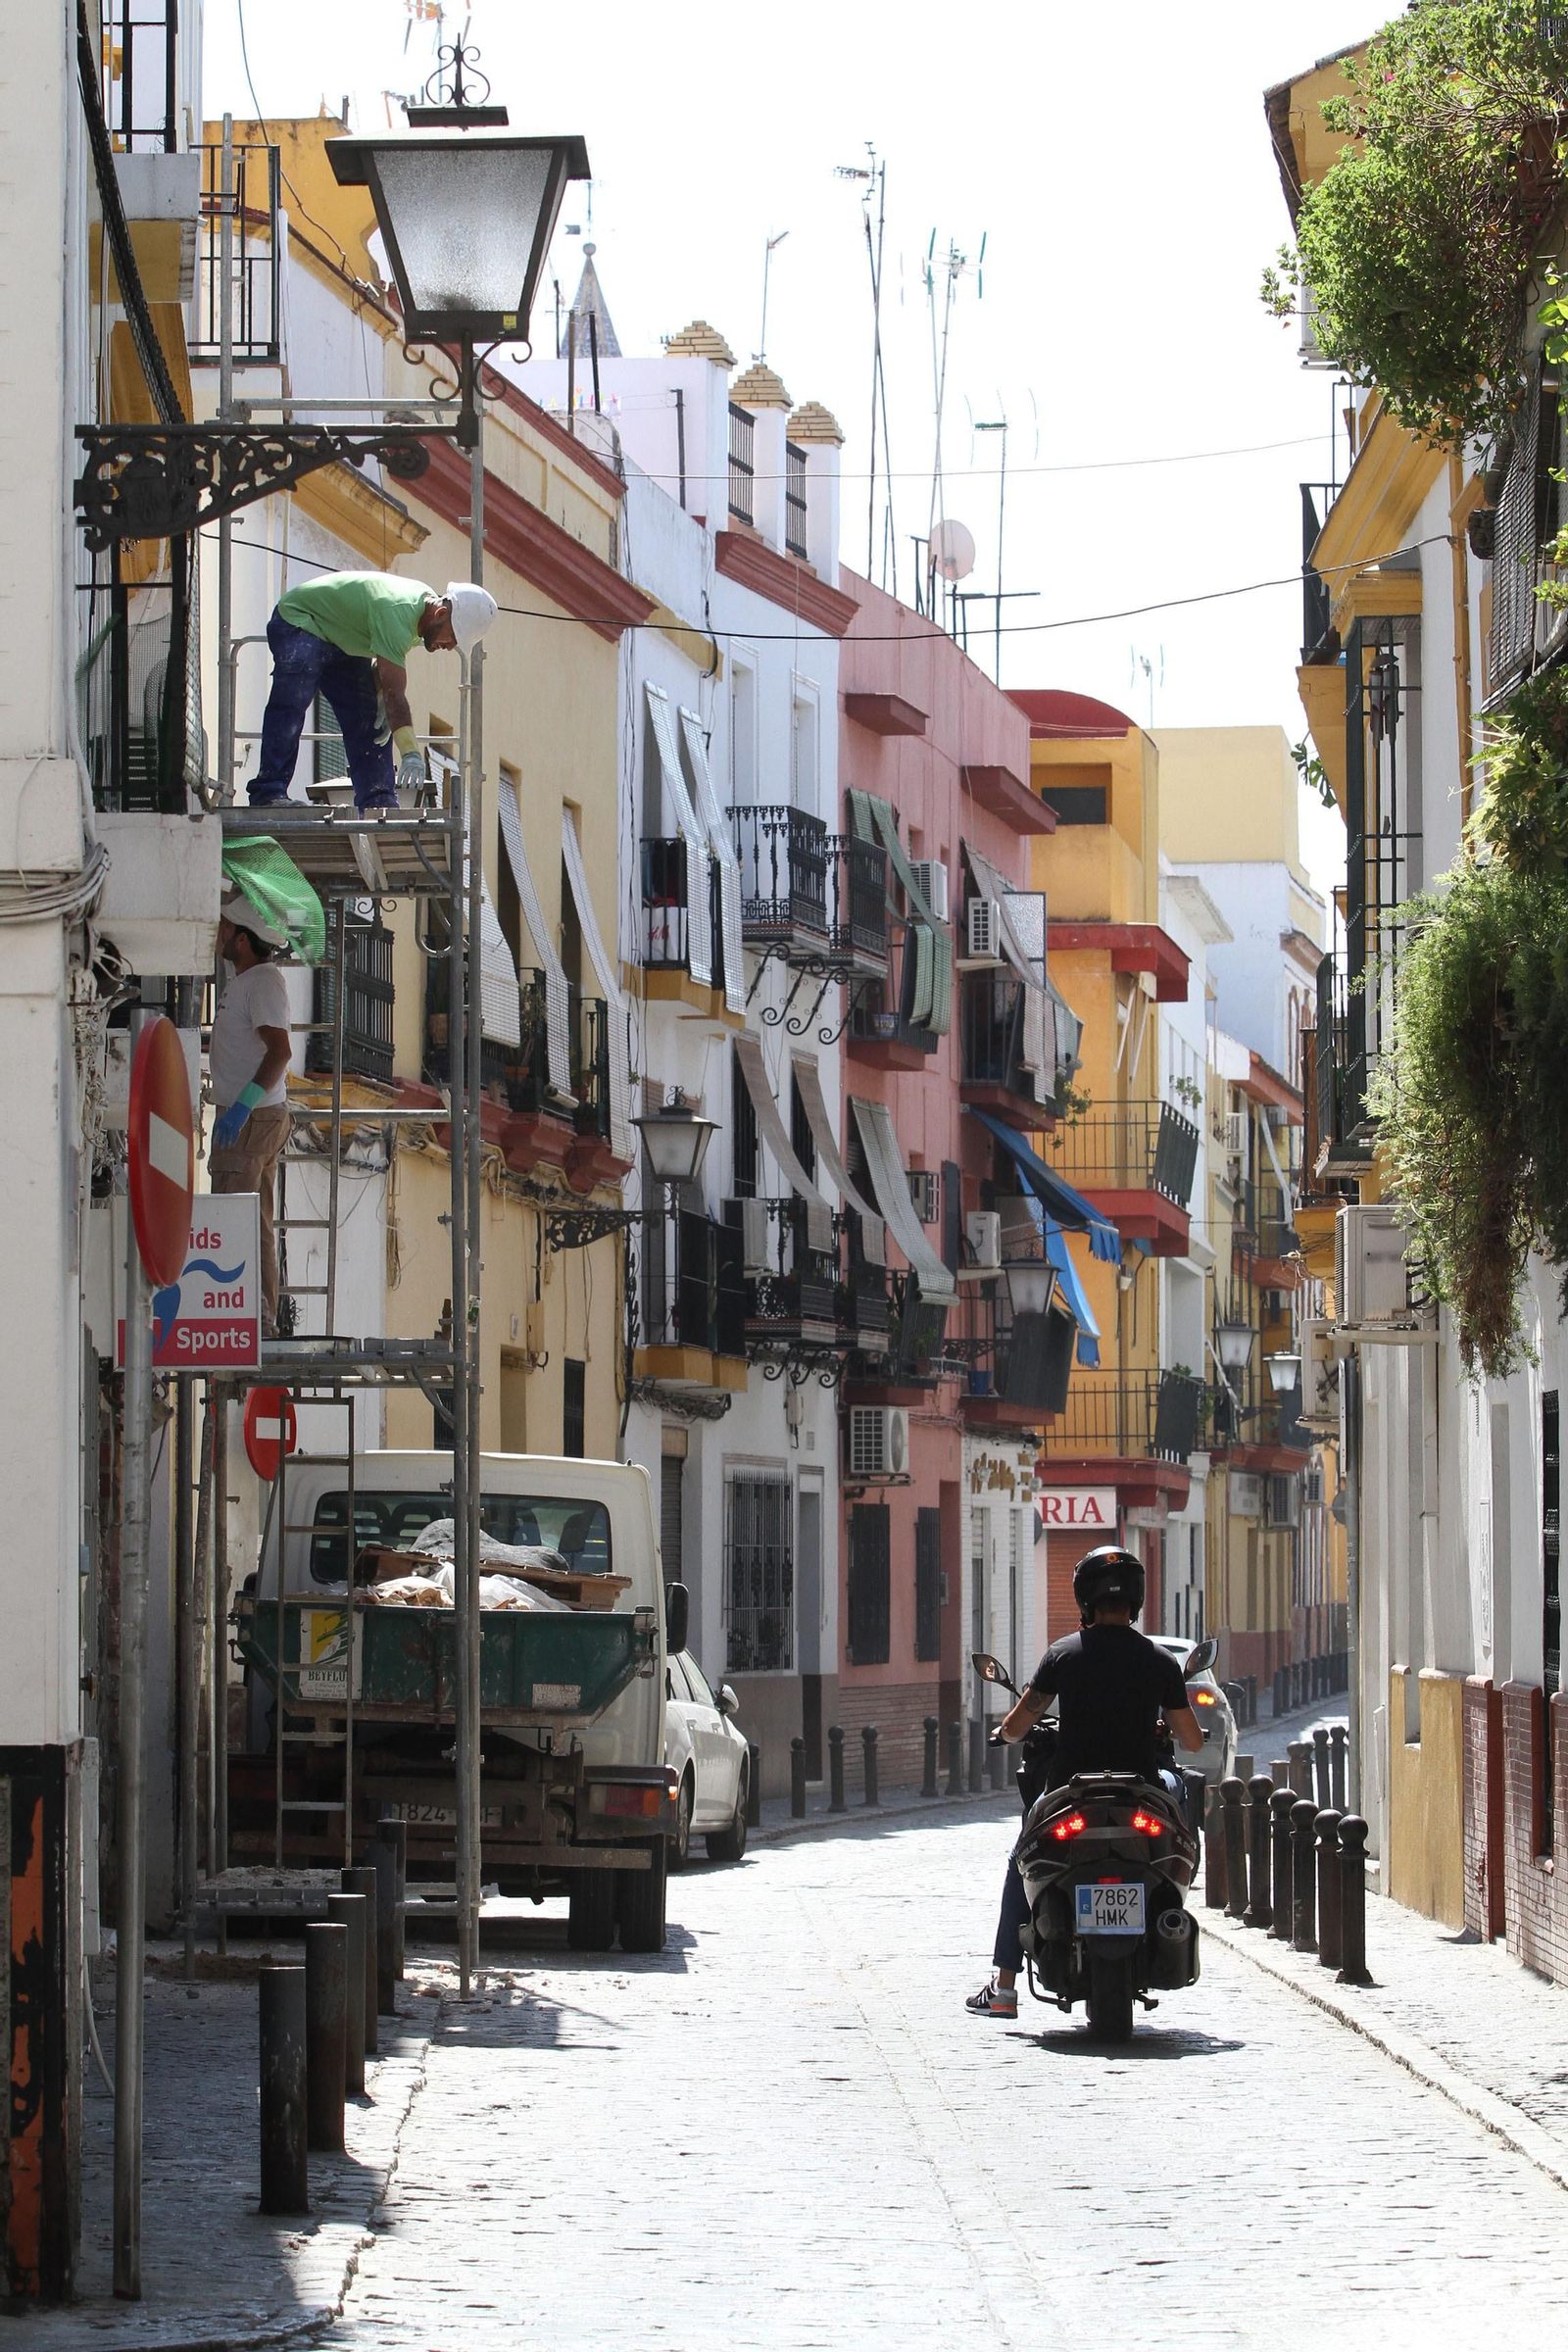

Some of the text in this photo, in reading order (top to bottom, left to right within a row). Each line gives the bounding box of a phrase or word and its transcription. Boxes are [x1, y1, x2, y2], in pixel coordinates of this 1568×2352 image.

[187, 1227, 221, 1250] ids
[203, 1286, 244, 1308] and
[176, 1327, 251, 1353] Sports
[1034, 1496, 1104, 1523] RIA
[308, 1670, 348, 1682] BEYFLU
[1094, 1888, 1138, 1906] 7862
[1096, 1909, 1128, 1926] HMK
